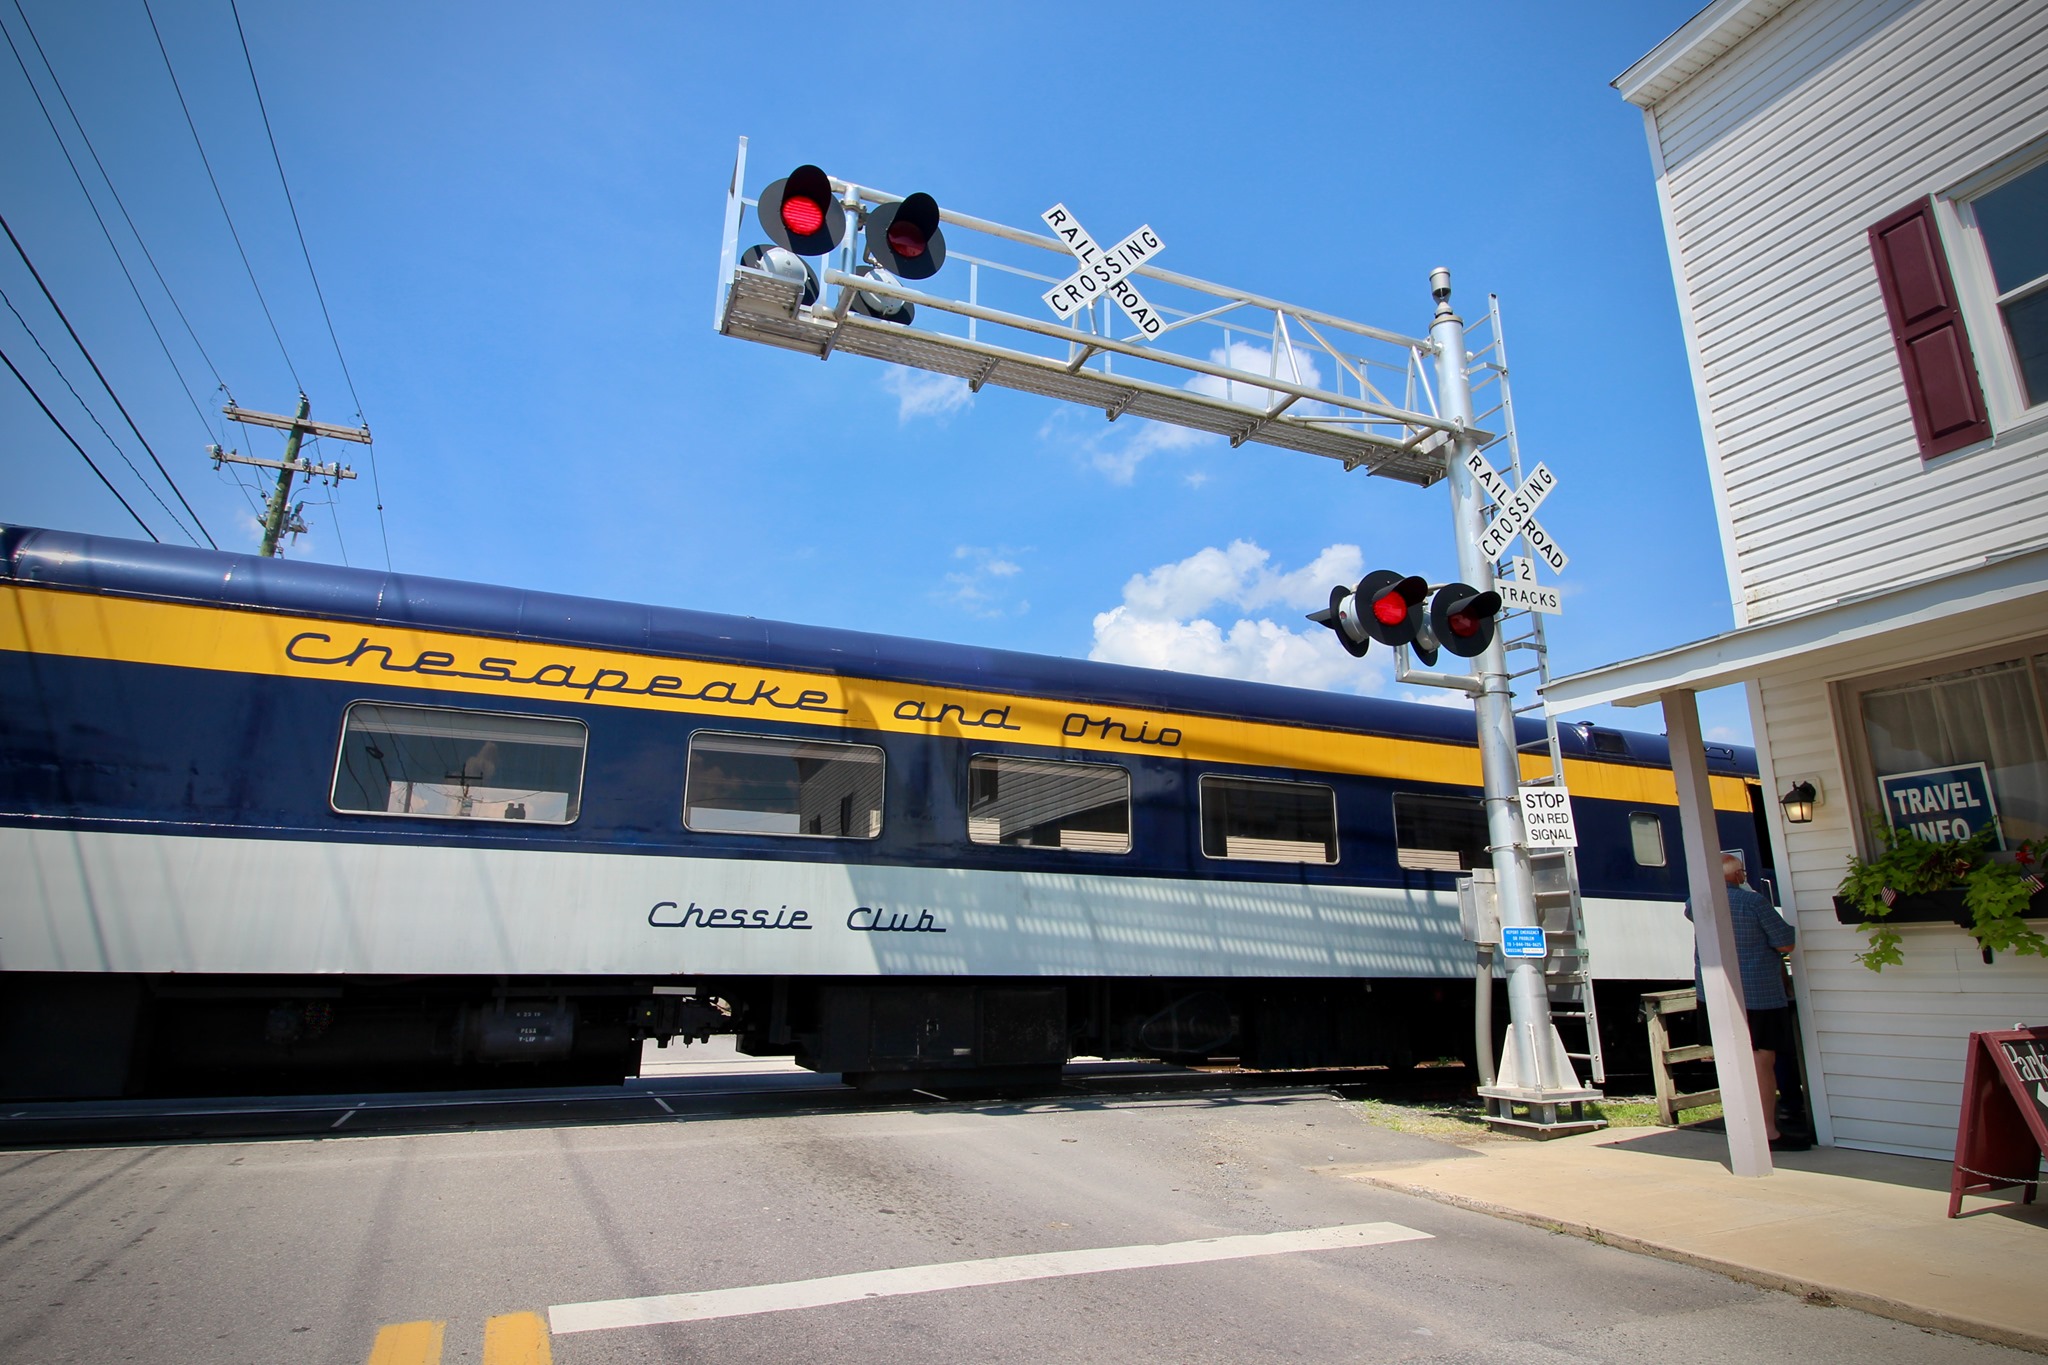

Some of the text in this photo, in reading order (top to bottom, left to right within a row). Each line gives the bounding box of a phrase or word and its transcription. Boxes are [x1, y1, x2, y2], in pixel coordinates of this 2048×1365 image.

[1048, 209, 1160, 334] RAIL ROAD
[1051, 231, 1157, 312] CROSSING
[1469, 455, 1563, 568] RAIL ROAD
[1482, 469, 1552, 556] CROSSING
[1520, 563, 1531, 580] 2
[1500, 586, 1557, 608] TRACKS
[285, 631, 848, 714] Chesapeake
[893, 699, 1021, 731] and
[1526, 793, 1565, 809] STOP
[1893, 781, 1981, 815] TRAVEL
[1528, 813, 1569, 824] ON RED
[1531, 828, 1572, 841] SIGNAL
[648, 901, 947, 932] Chessie Club
